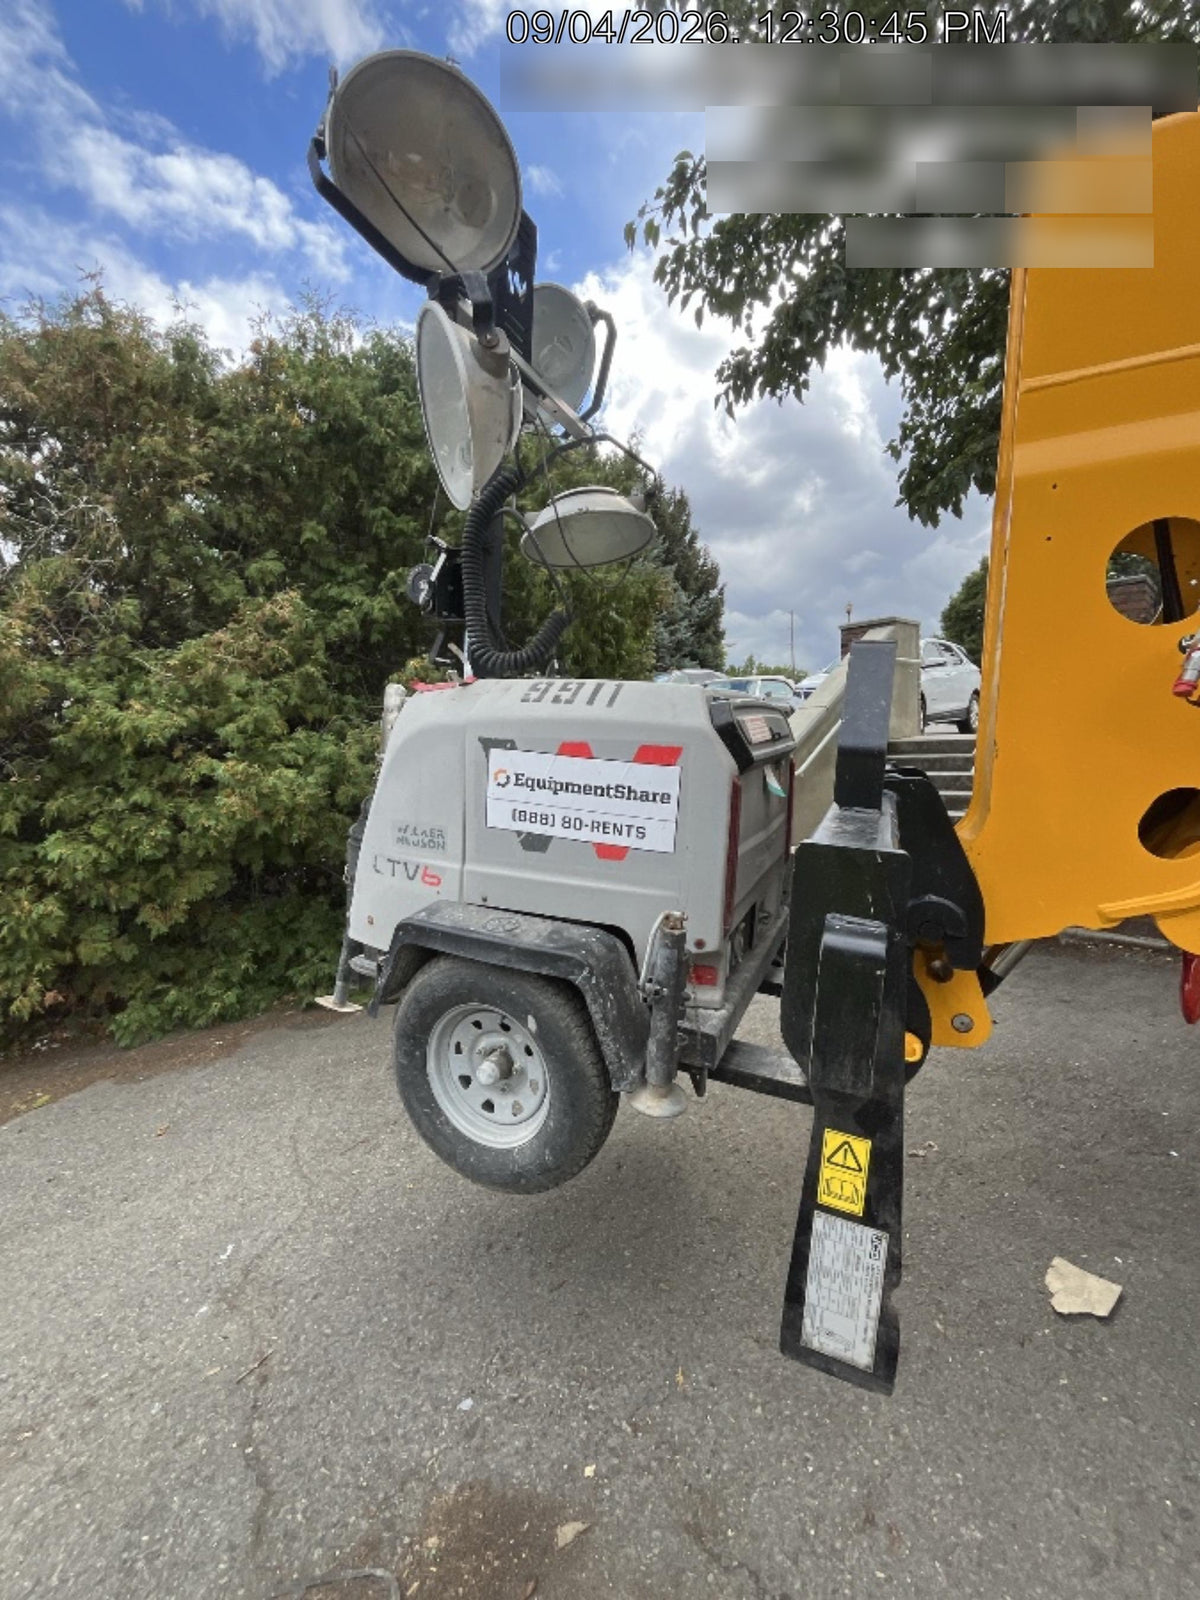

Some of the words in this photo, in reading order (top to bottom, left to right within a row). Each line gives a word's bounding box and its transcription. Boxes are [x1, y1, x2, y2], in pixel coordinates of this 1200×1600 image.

[521, 681, 624, 708] 9911
[513, 772, 671, 804] EquipmentShare
[561, 818, 647, 840] 80-RENTS
